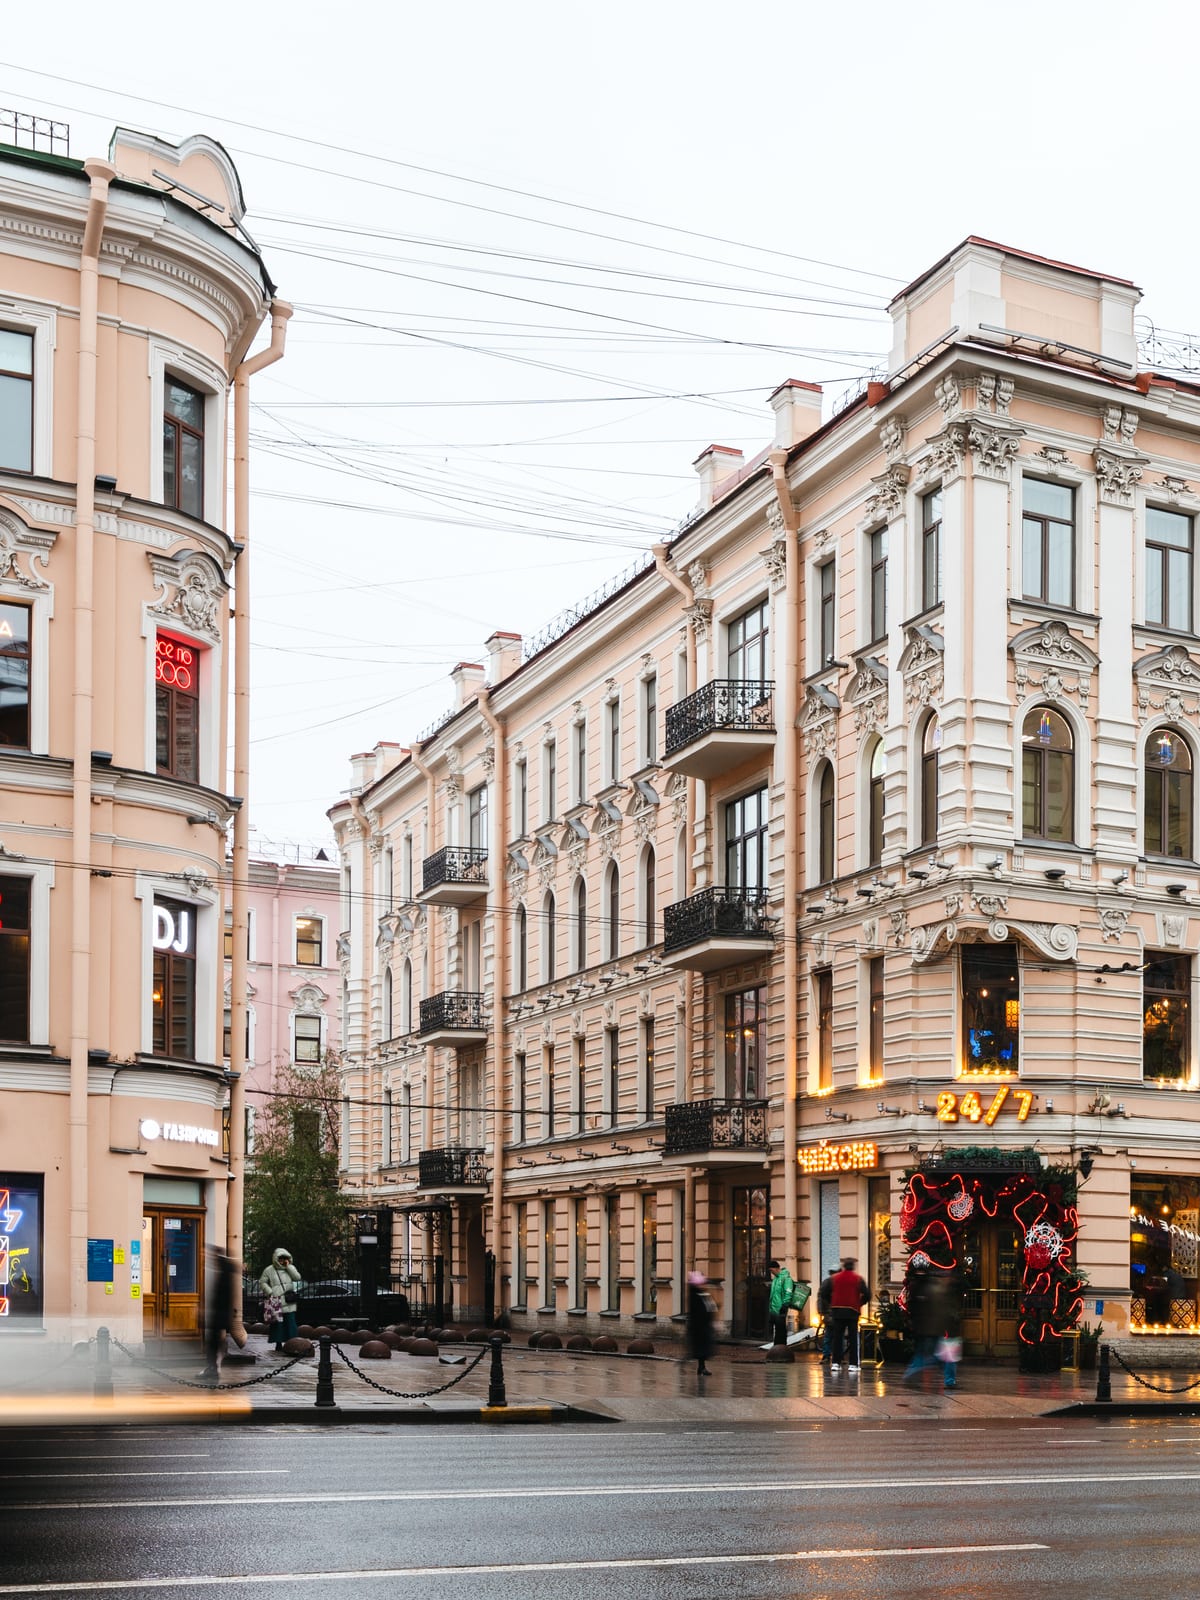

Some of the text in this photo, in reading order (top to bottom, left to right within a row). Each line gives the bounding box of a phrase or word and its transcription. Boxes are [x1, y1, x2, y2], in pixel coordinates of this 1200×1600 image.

[176, 647, 193, 665] по
[153, 905, 189, 953] DJ
[936, 1084, 1034, 1126] 24/7
[797, 1139, 879, 1174] ЧАЙХОНА
